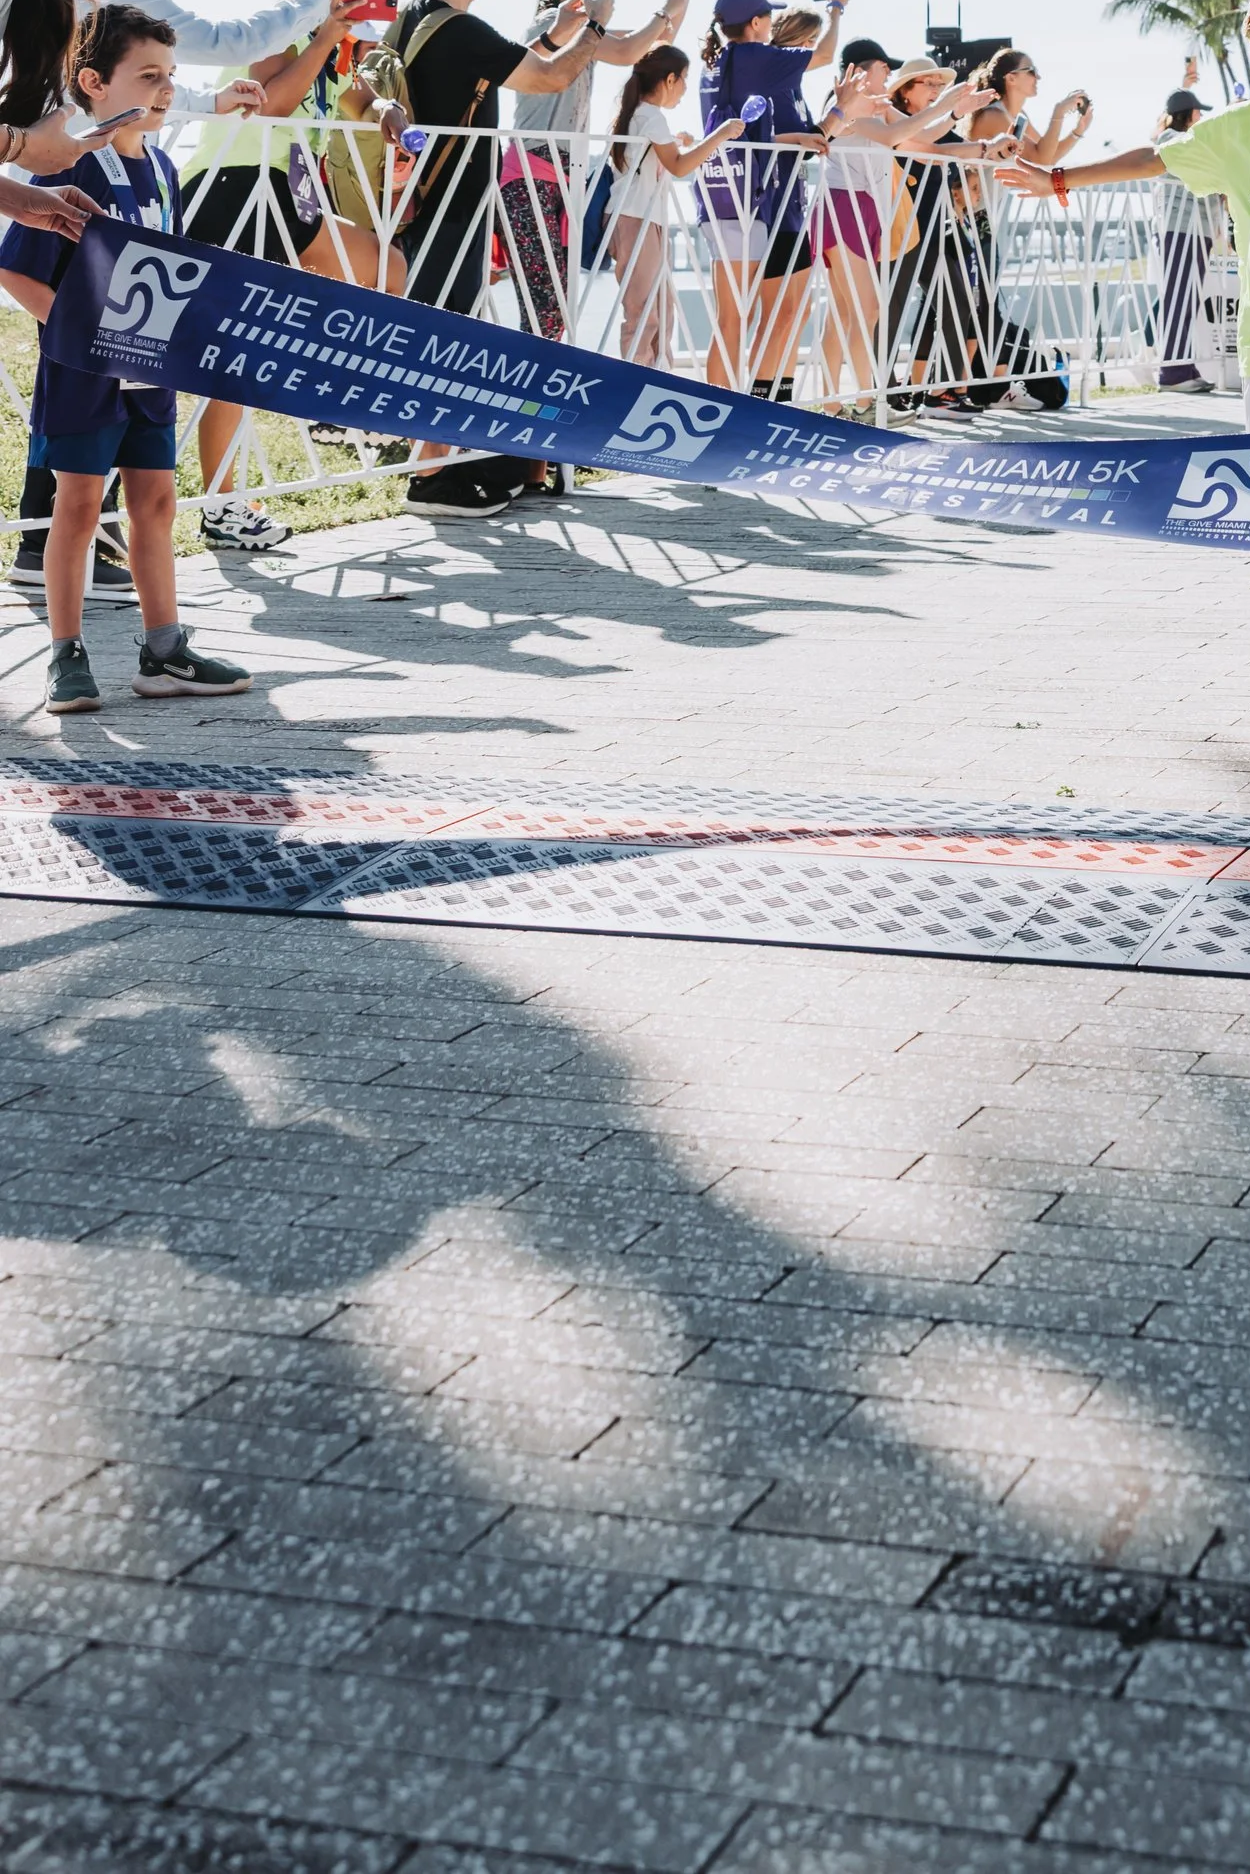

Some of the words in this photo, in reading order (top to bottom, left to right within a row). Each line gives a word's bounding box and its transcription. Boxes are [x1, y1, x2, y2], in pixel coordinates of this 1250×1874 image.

[97, 329, 113, 341] THE
[114, 333, 132, 345] GIVE
[133, 337, 156, 350] MIAMI
[156, 343, 169, 353] 5K
[240, 282, 319, 329] THE
[323, 309, 416, 356] GIVE
[419, 334, 540, 390] MIAMI
[542, 368, 604, 406] 5K
[199, 344, 558, 450] RACE+FESTIVAL
[766, 423, 846, 457] THE
[853, 444, 950, 472] GIVE
[956, 457, 1081, 481] MIAMI
[1088, 459, 1149, 484] 5K
[1188, 520, 1214, 528] GIVE
[1214, 521, 1247, 530] MIAMI
